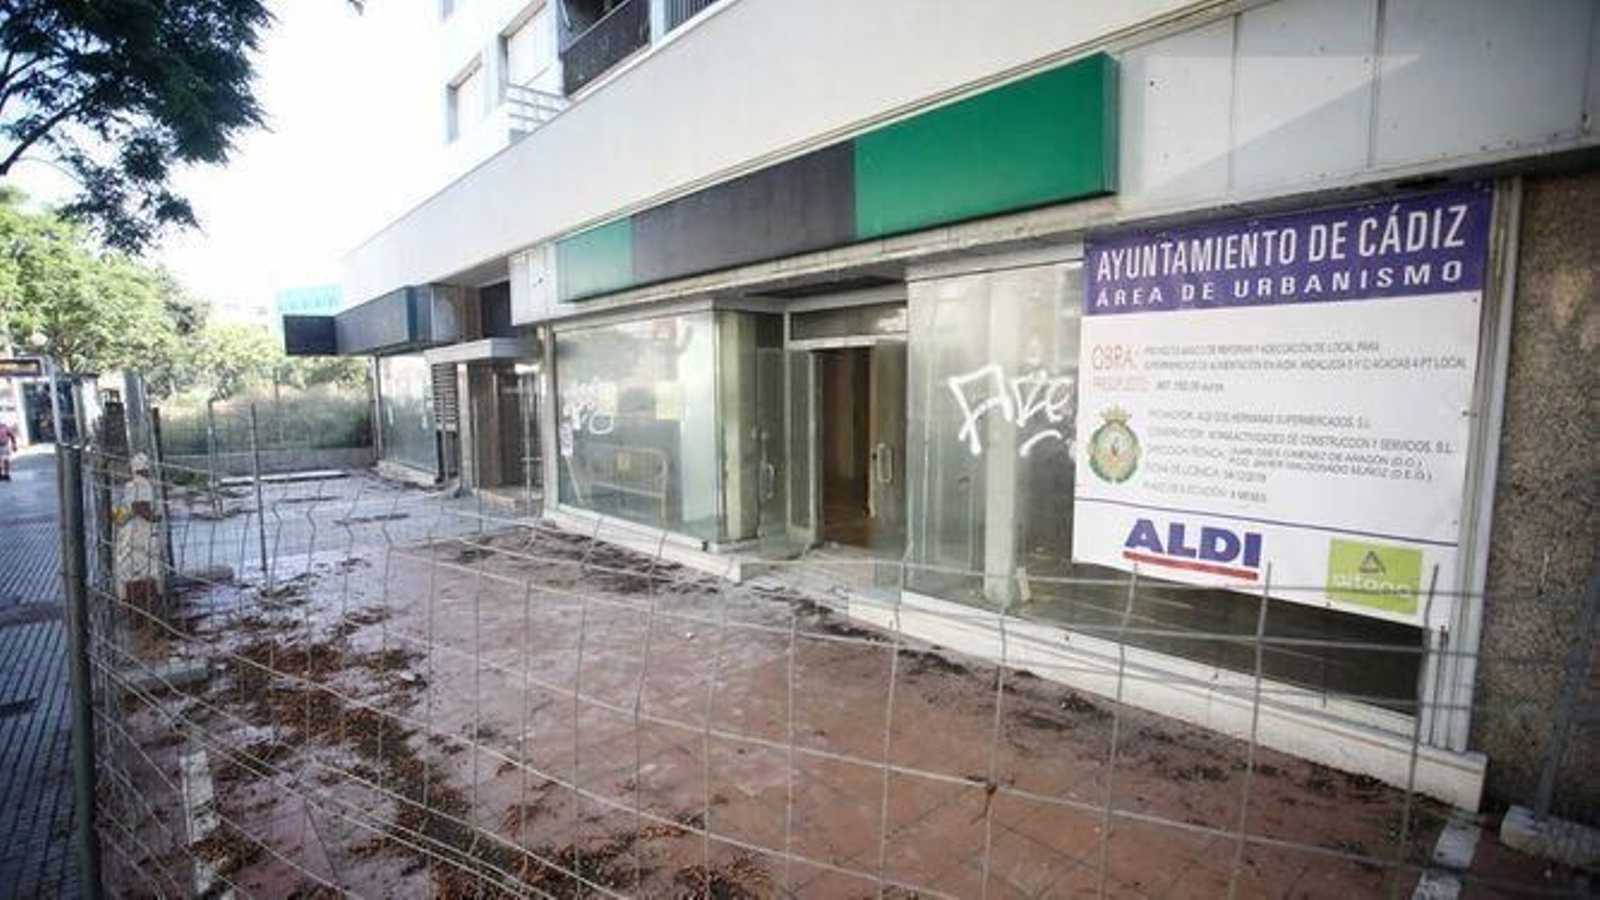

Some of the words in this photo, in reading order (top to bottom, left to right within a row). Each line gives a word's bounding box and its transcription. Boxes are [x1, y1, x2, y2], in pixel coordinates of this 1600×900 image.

[1096, 228, 1297, 283] AYUNTAMIENTO
[1308, 221, 1349, 263] DE
[1358, 203, 1469, 258] CÁDIZ
[1181, 283, 1214, 302] DE
[1234, 260, 1464, 298] URBANISMO
[1123, 518, 1263, 569] ALDI
